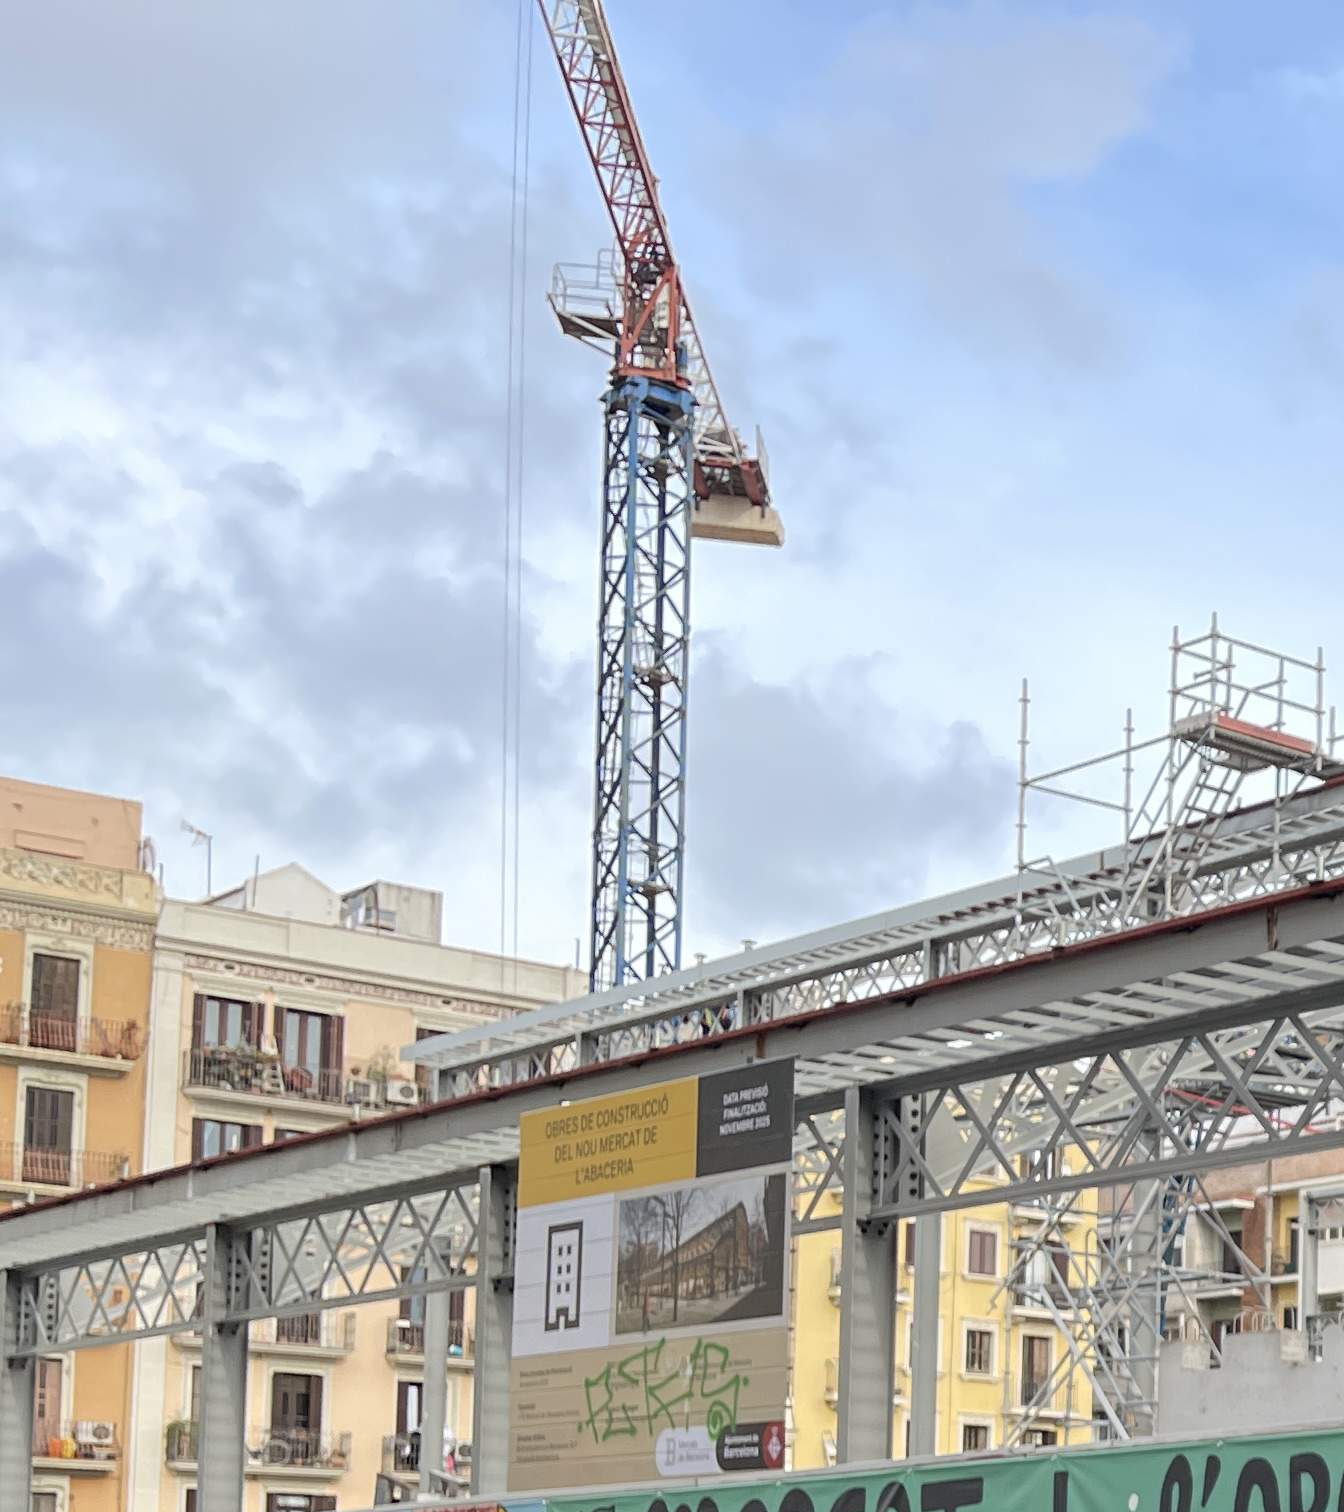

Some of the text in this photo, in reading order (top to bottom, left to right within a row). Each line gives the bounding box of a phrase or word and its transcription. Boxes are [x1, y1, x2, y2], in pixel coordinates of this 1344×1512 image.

[545, 1094, 669, 1139] OBRES DE CONSTRUCCIÓ
[554, 1126, 657, 1164] DEL NOU MERCAT DE
[575, 1157, 634, 1185] L'ABACERIA
